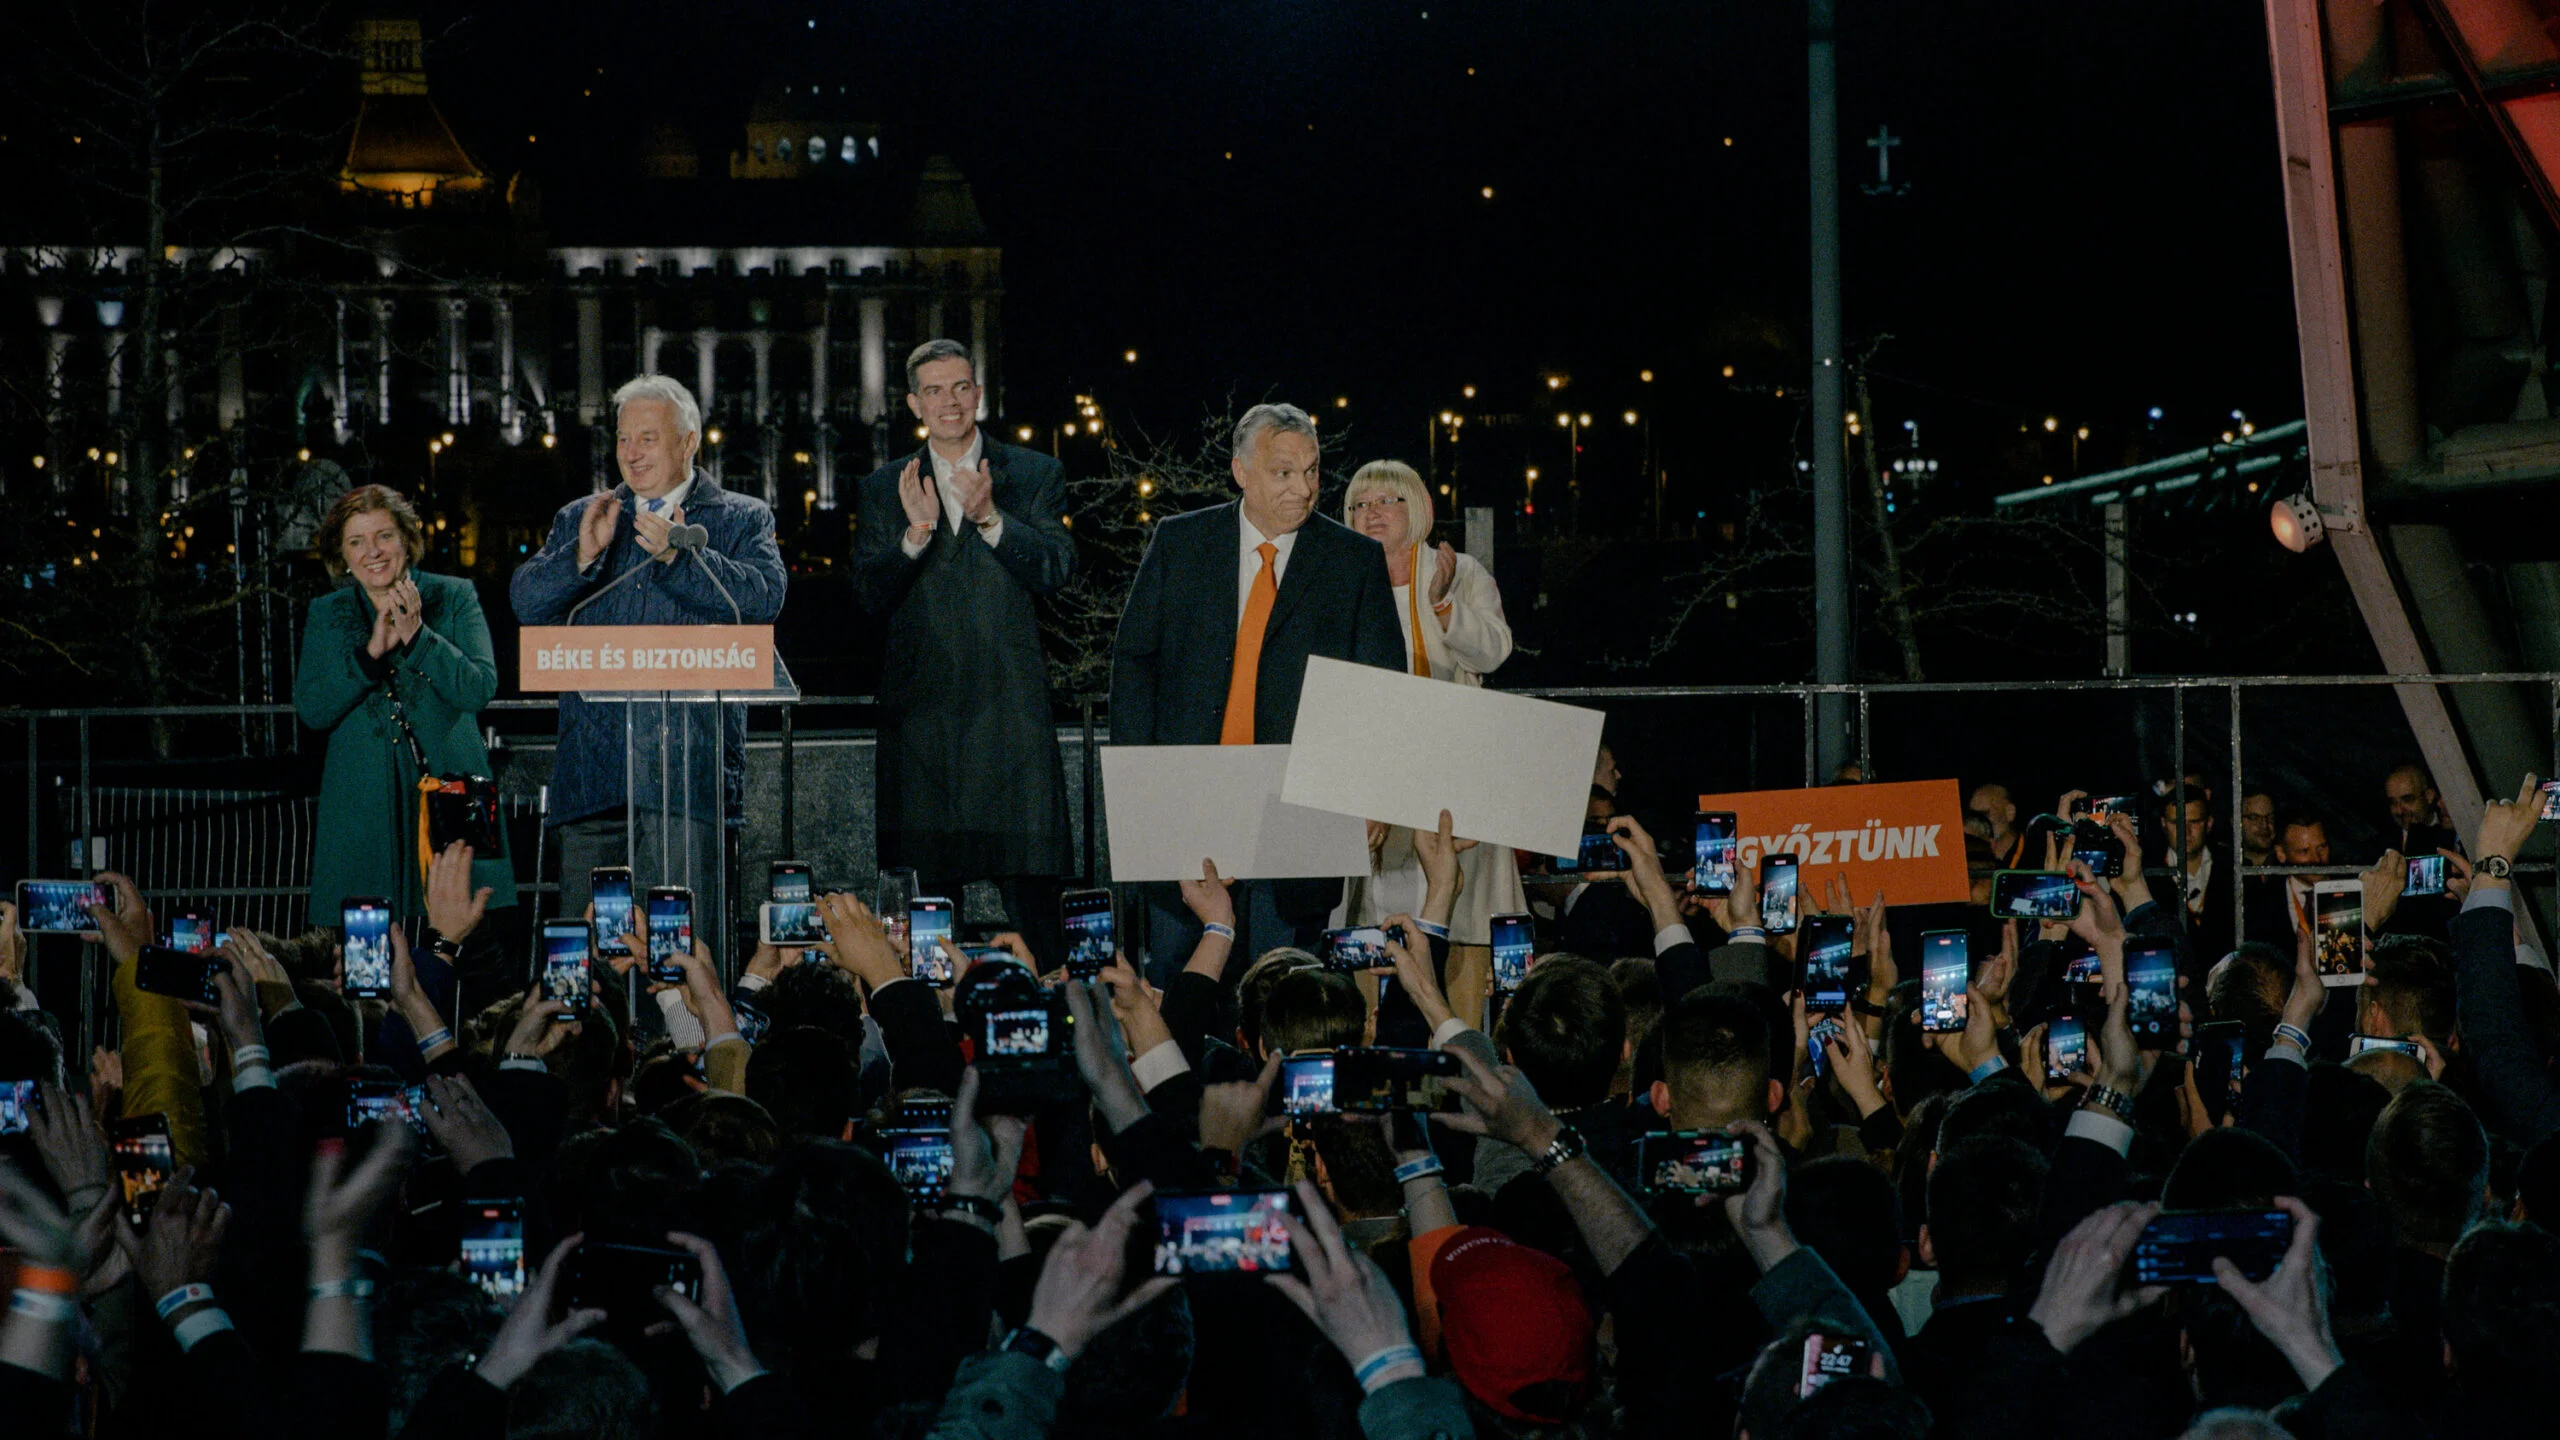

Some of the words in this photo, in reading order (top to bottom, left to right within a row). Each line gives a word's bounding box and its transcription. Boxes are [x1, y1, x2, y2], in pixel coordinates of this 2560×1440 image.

[537, 643, 592, 670] BÉKE
[600, 643, 626, 669] ÉS
[632, 642, 756, 669] BIZTONSÁG
[1736, 819, 1940, 869] GYŐZTÜNK
